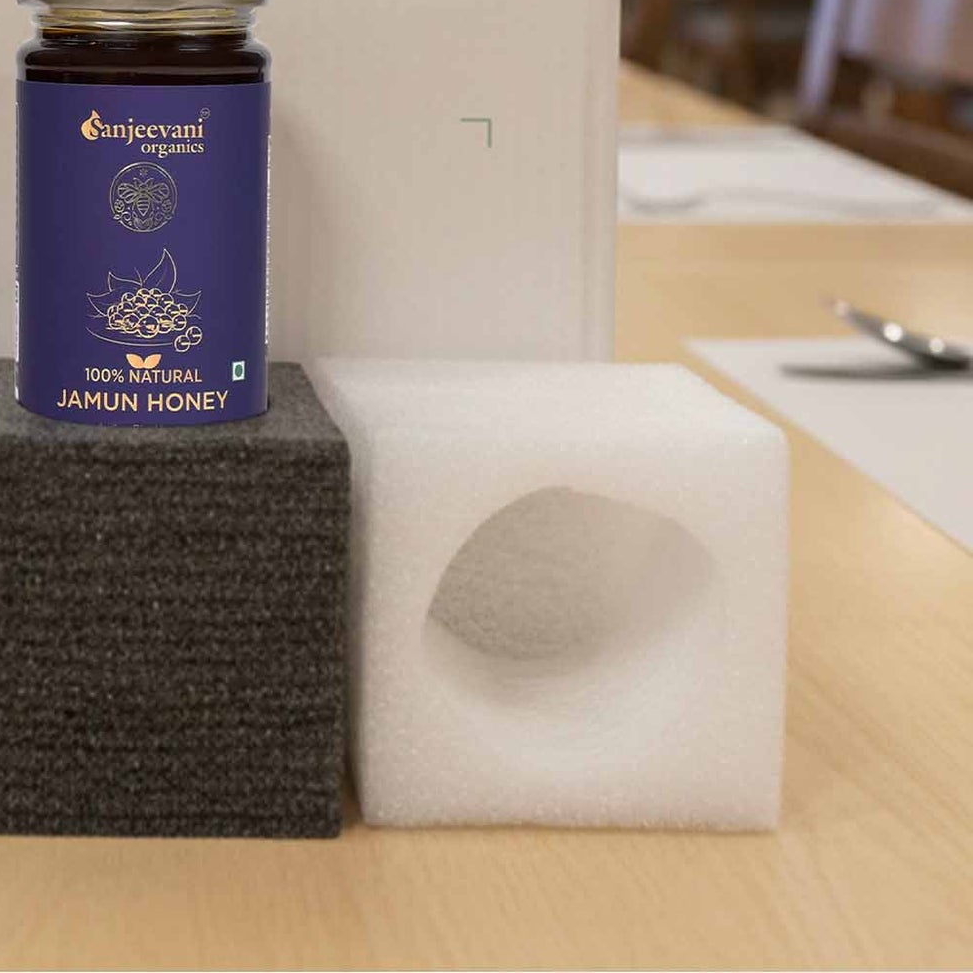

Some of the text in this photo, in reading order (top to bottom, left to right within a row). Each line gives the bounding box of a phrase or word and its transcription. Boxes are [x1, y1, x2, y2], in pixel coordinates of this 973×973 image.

[89, 117, 203, 145] Sanjeevani
[140, 139, 204, 158] organics
[85, 367, 202, 383] 100% NATURAL
[56, 388, 228, 411] JAMUN HONEY
